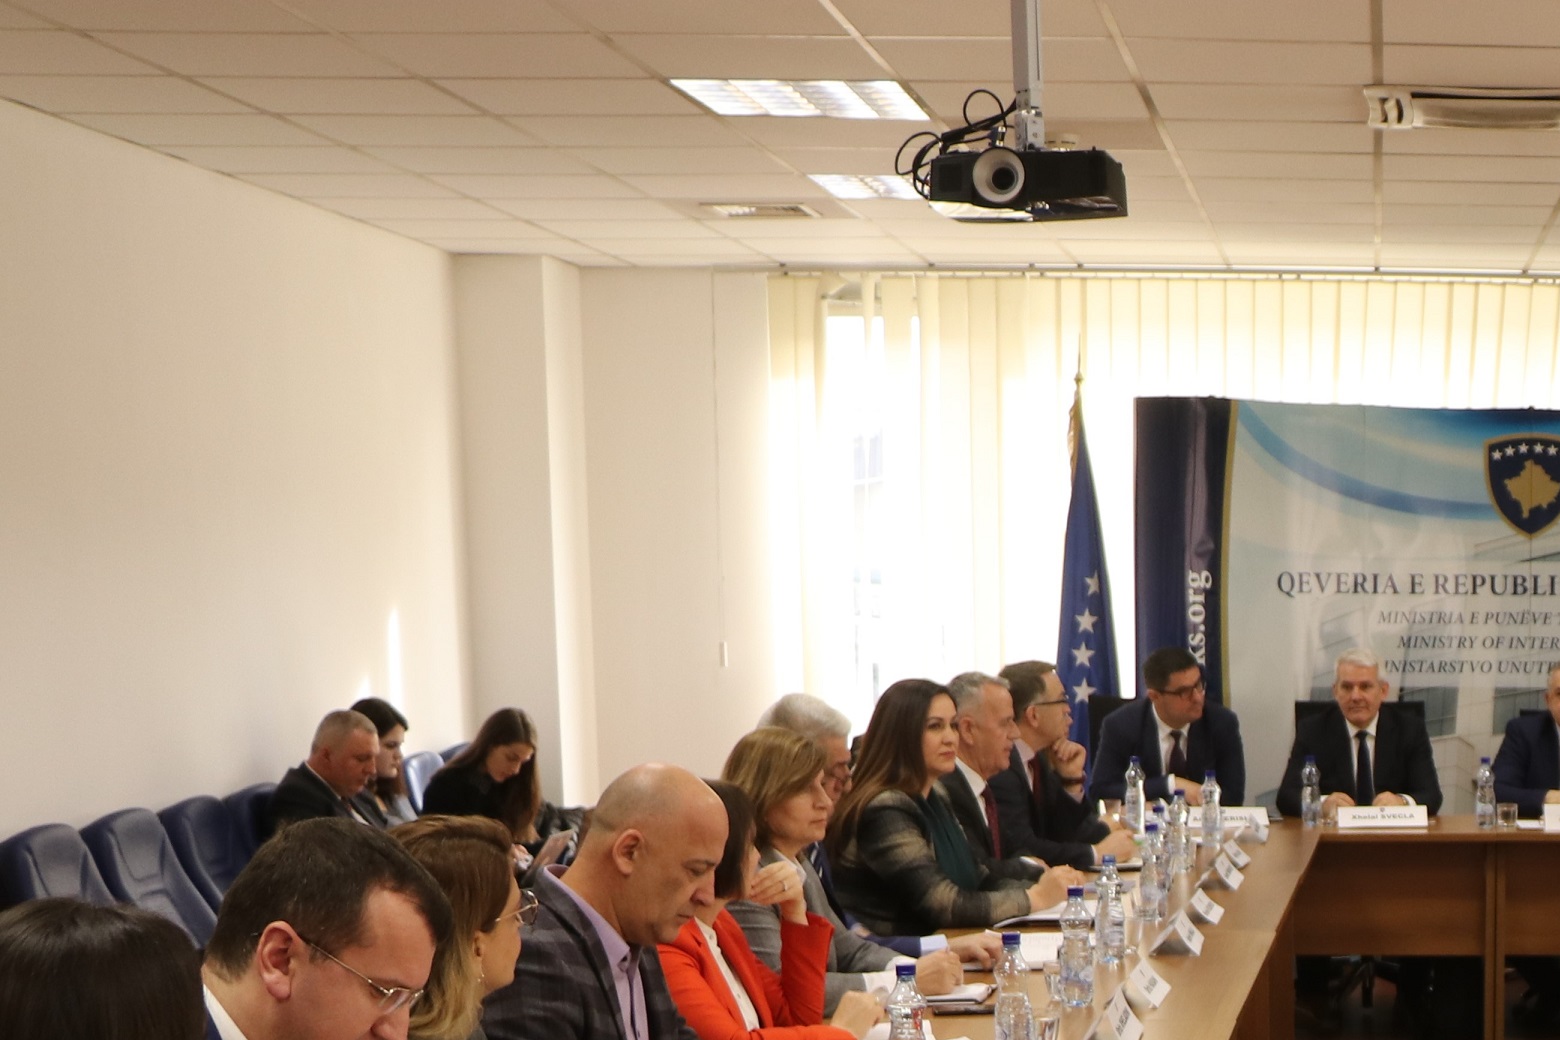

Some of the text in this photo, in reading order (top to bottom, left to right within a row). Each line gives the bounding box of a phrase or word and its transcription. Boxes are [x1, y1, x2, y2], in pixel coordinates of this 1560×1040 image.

[1277, 571, 1400, 597] QEVERIA
[1409, 573, 1425, 595] E
[1377, 610, 1463, 625] MINISTRIA
[1469, 611, 1480, 625] E
[1484, 609, 1551, 626] PUNËVE
[1397, 635, 1477, 649] MINISTRY
[1482, 635, 1504, 649] OF
[1384, 659, 1492, 674] INISTARSTVO
